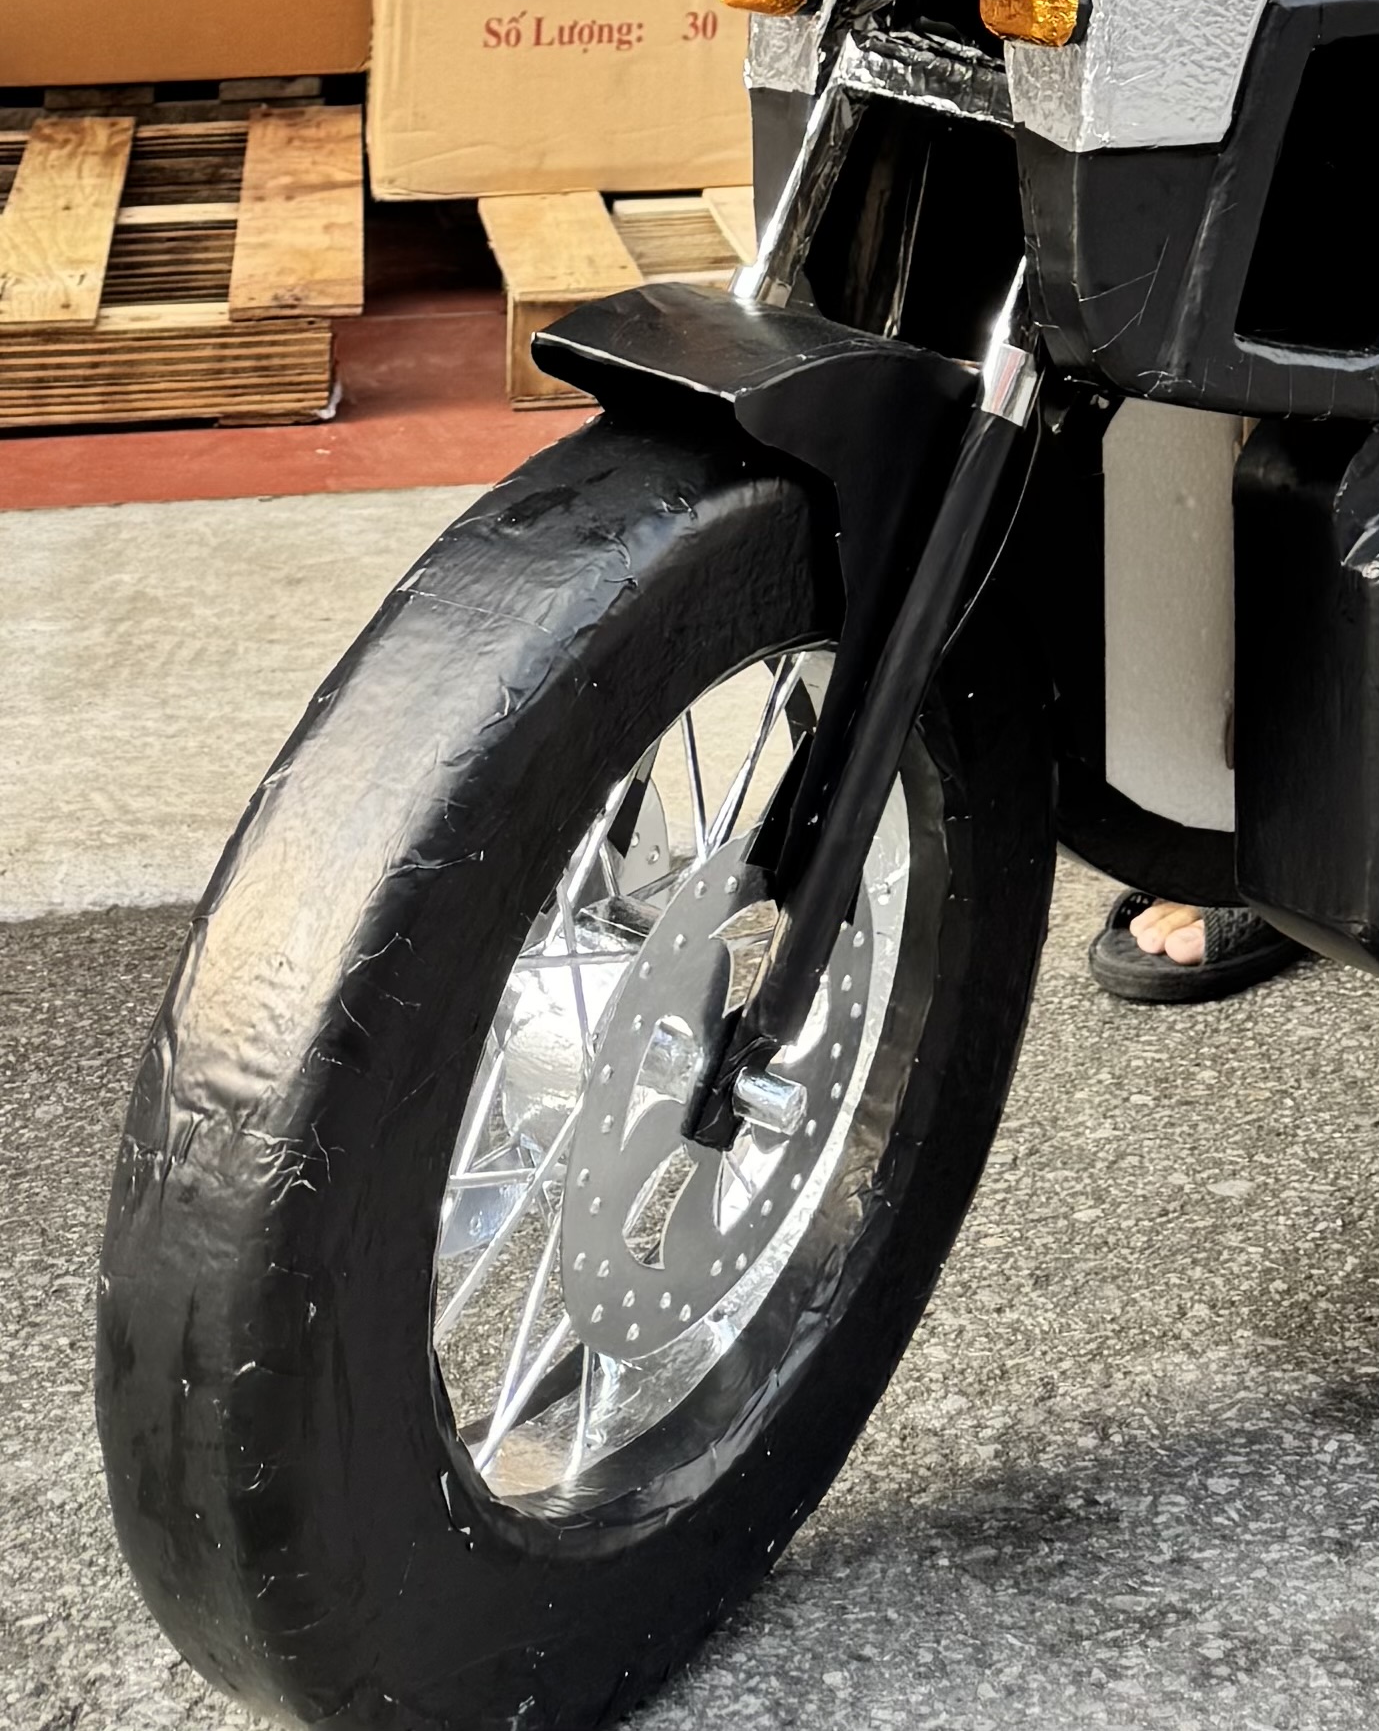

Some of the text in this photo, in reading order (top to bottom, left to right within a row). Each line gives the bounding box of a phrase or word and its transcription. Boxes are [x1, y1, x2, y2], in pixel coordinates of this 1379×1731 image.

[483, 10, 719, 54] Số Lượng: 30
